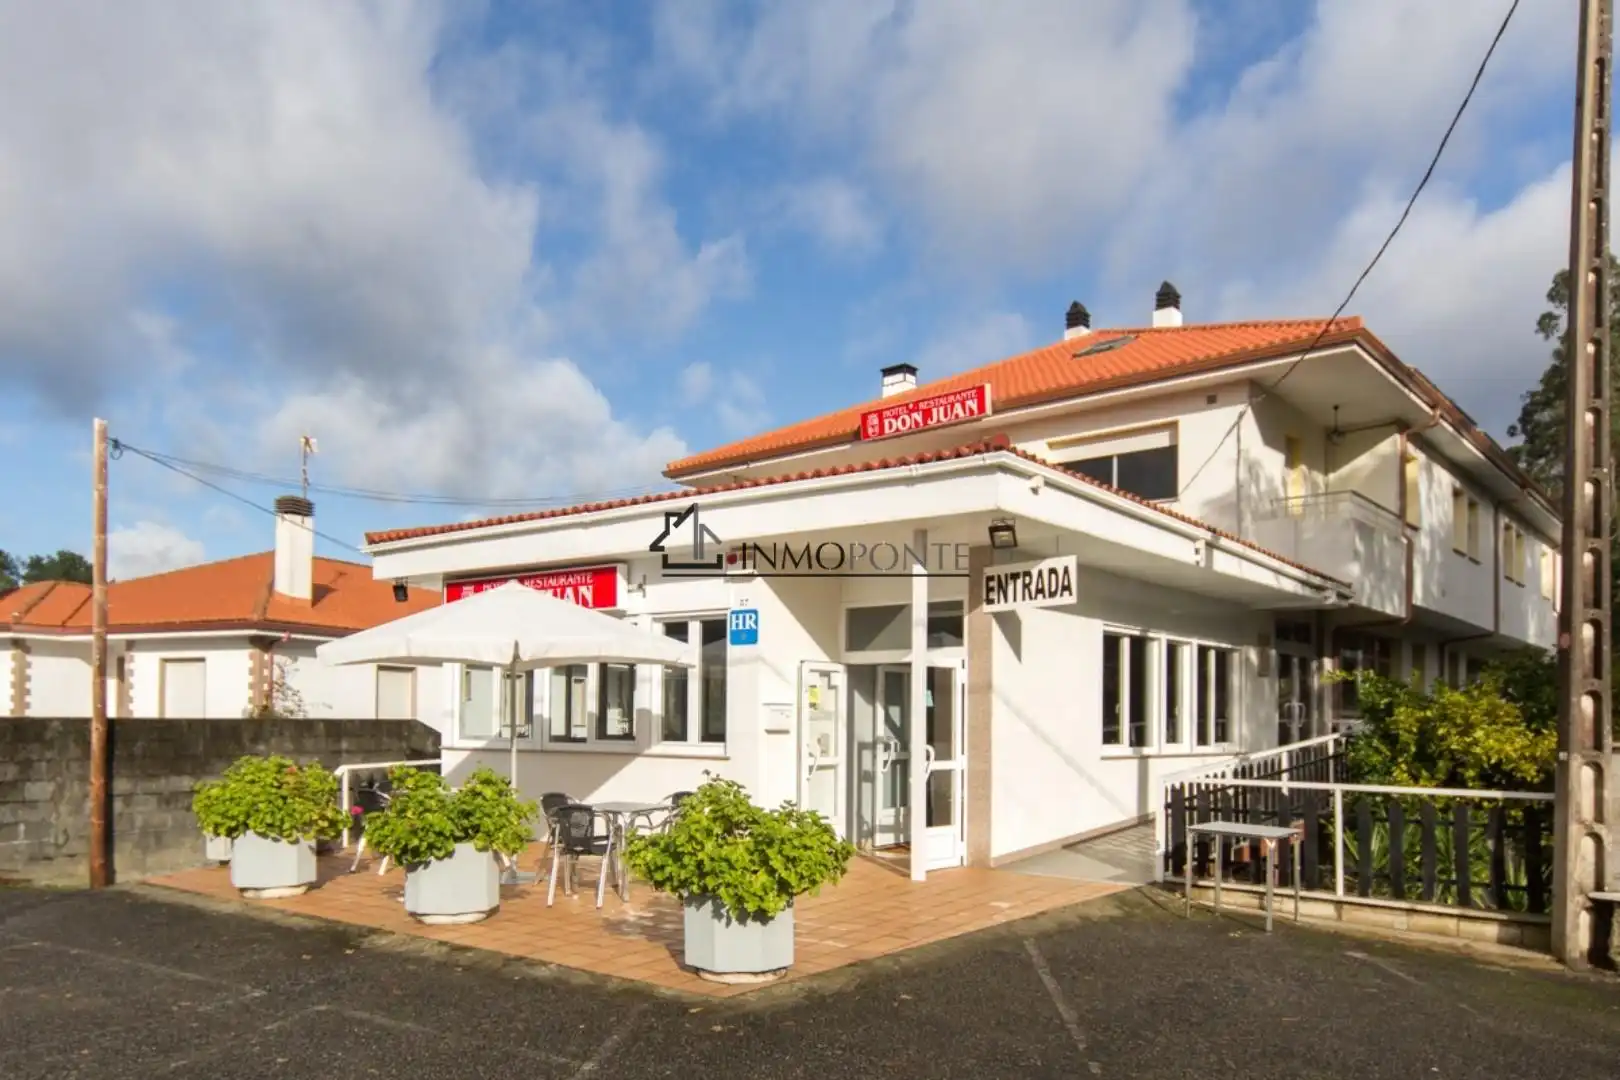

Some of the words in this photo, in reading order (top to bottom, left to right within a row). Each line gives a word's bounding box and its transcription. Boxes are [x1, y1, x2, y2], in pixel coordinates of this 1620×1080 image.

[882, 405, 909, 417] HOTEL
[918, 389, 978, 409] RESTAURANTE
[883, 411, 923, 434] DON
[927, 399, 978, 425] JUAN
[984, 565, 1073, 605] ENTRADA
[731, 612, 757, 630] HR
